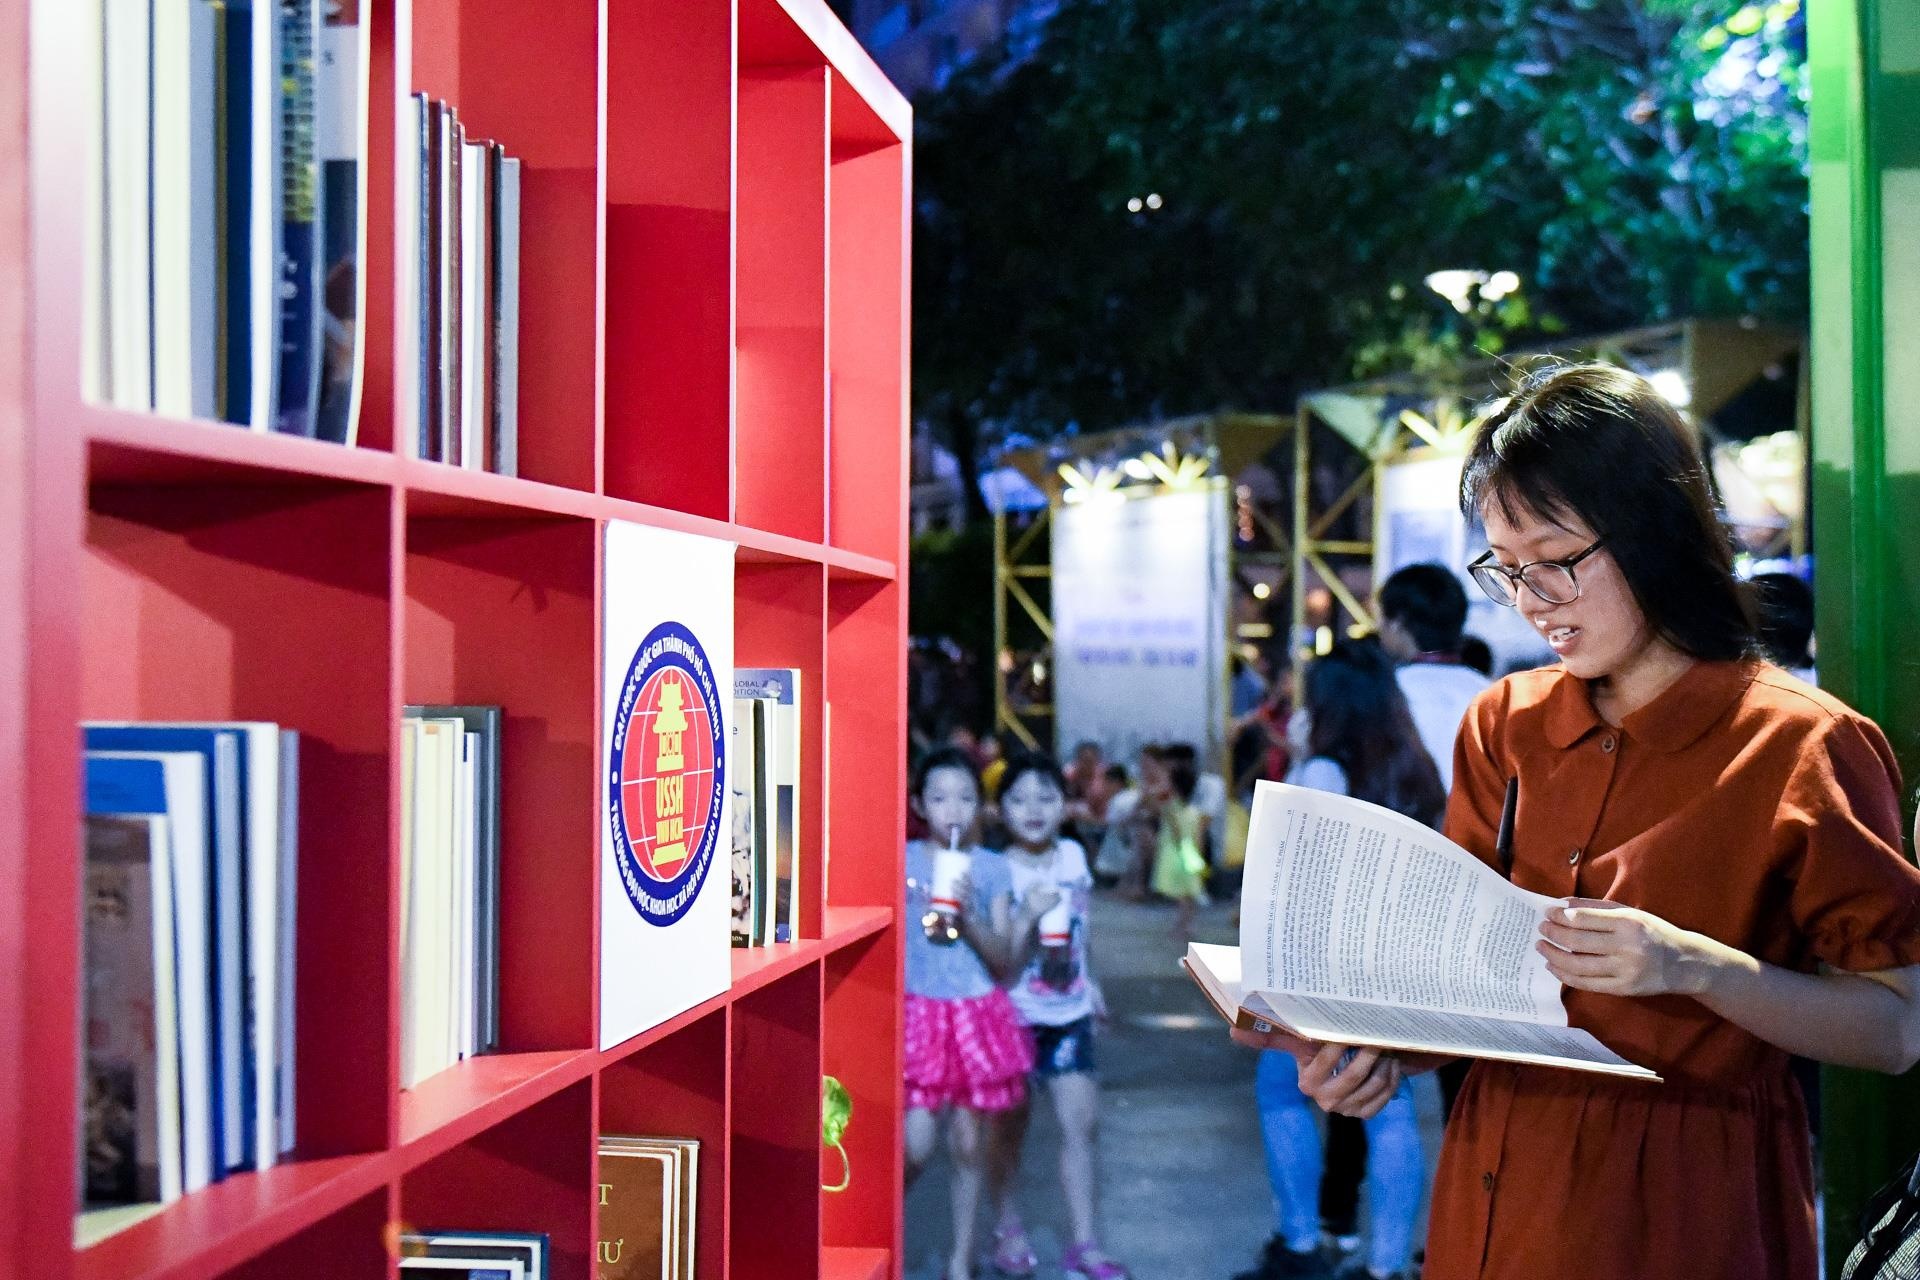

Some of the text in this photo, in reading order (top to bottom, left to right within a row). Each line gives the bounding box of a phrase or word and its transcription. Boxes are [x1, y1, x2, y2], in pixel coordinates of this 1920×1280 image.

[652, 639, 663, 659] GIA
[709, 696, 721, 740] MINH
[656, 775, 684, 818] USSH
[649, 898, 666, 916] KHOA
